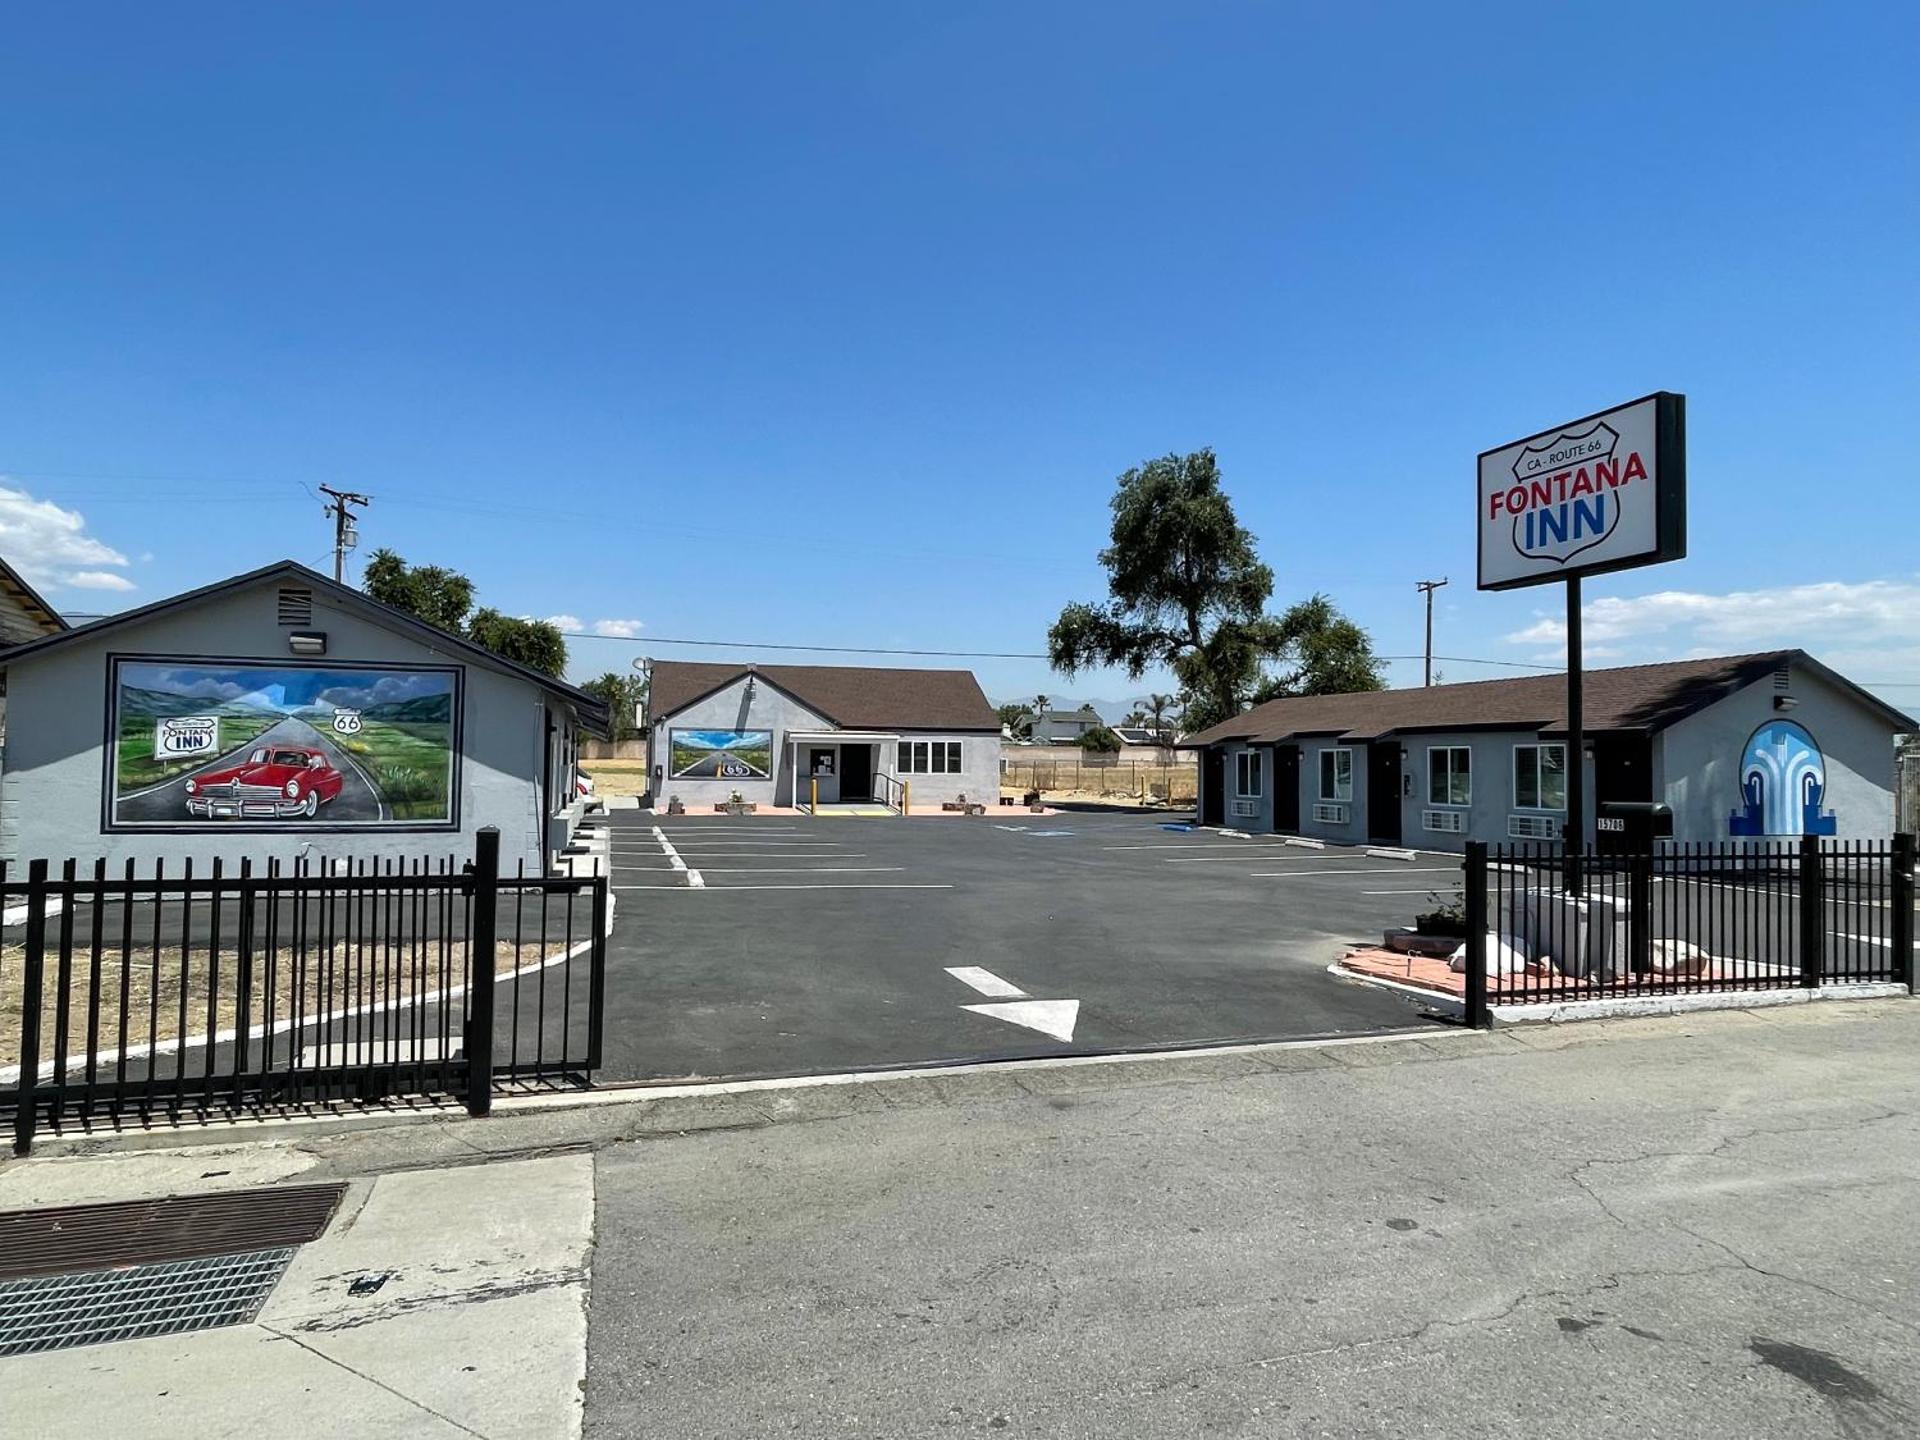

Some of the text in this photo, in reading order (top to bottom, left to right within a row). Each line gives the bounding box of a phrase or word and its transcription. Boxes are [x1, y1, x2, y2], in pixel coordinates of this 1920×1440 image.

[1526, 457, 1542, 471] CA
[1549, 445, 1585, 465] ROUTE
[1587, 440, 1602, 453] 66
[1489, 451, 1648, 520] FONTANA
[1526, 494, 1604, 550] INN
[337, 717, 359, 730] 66
[162, 729, 215, 737] FONTANA
[176, 736, 203, 749] INN
[727, 765, 743, 775] 66
